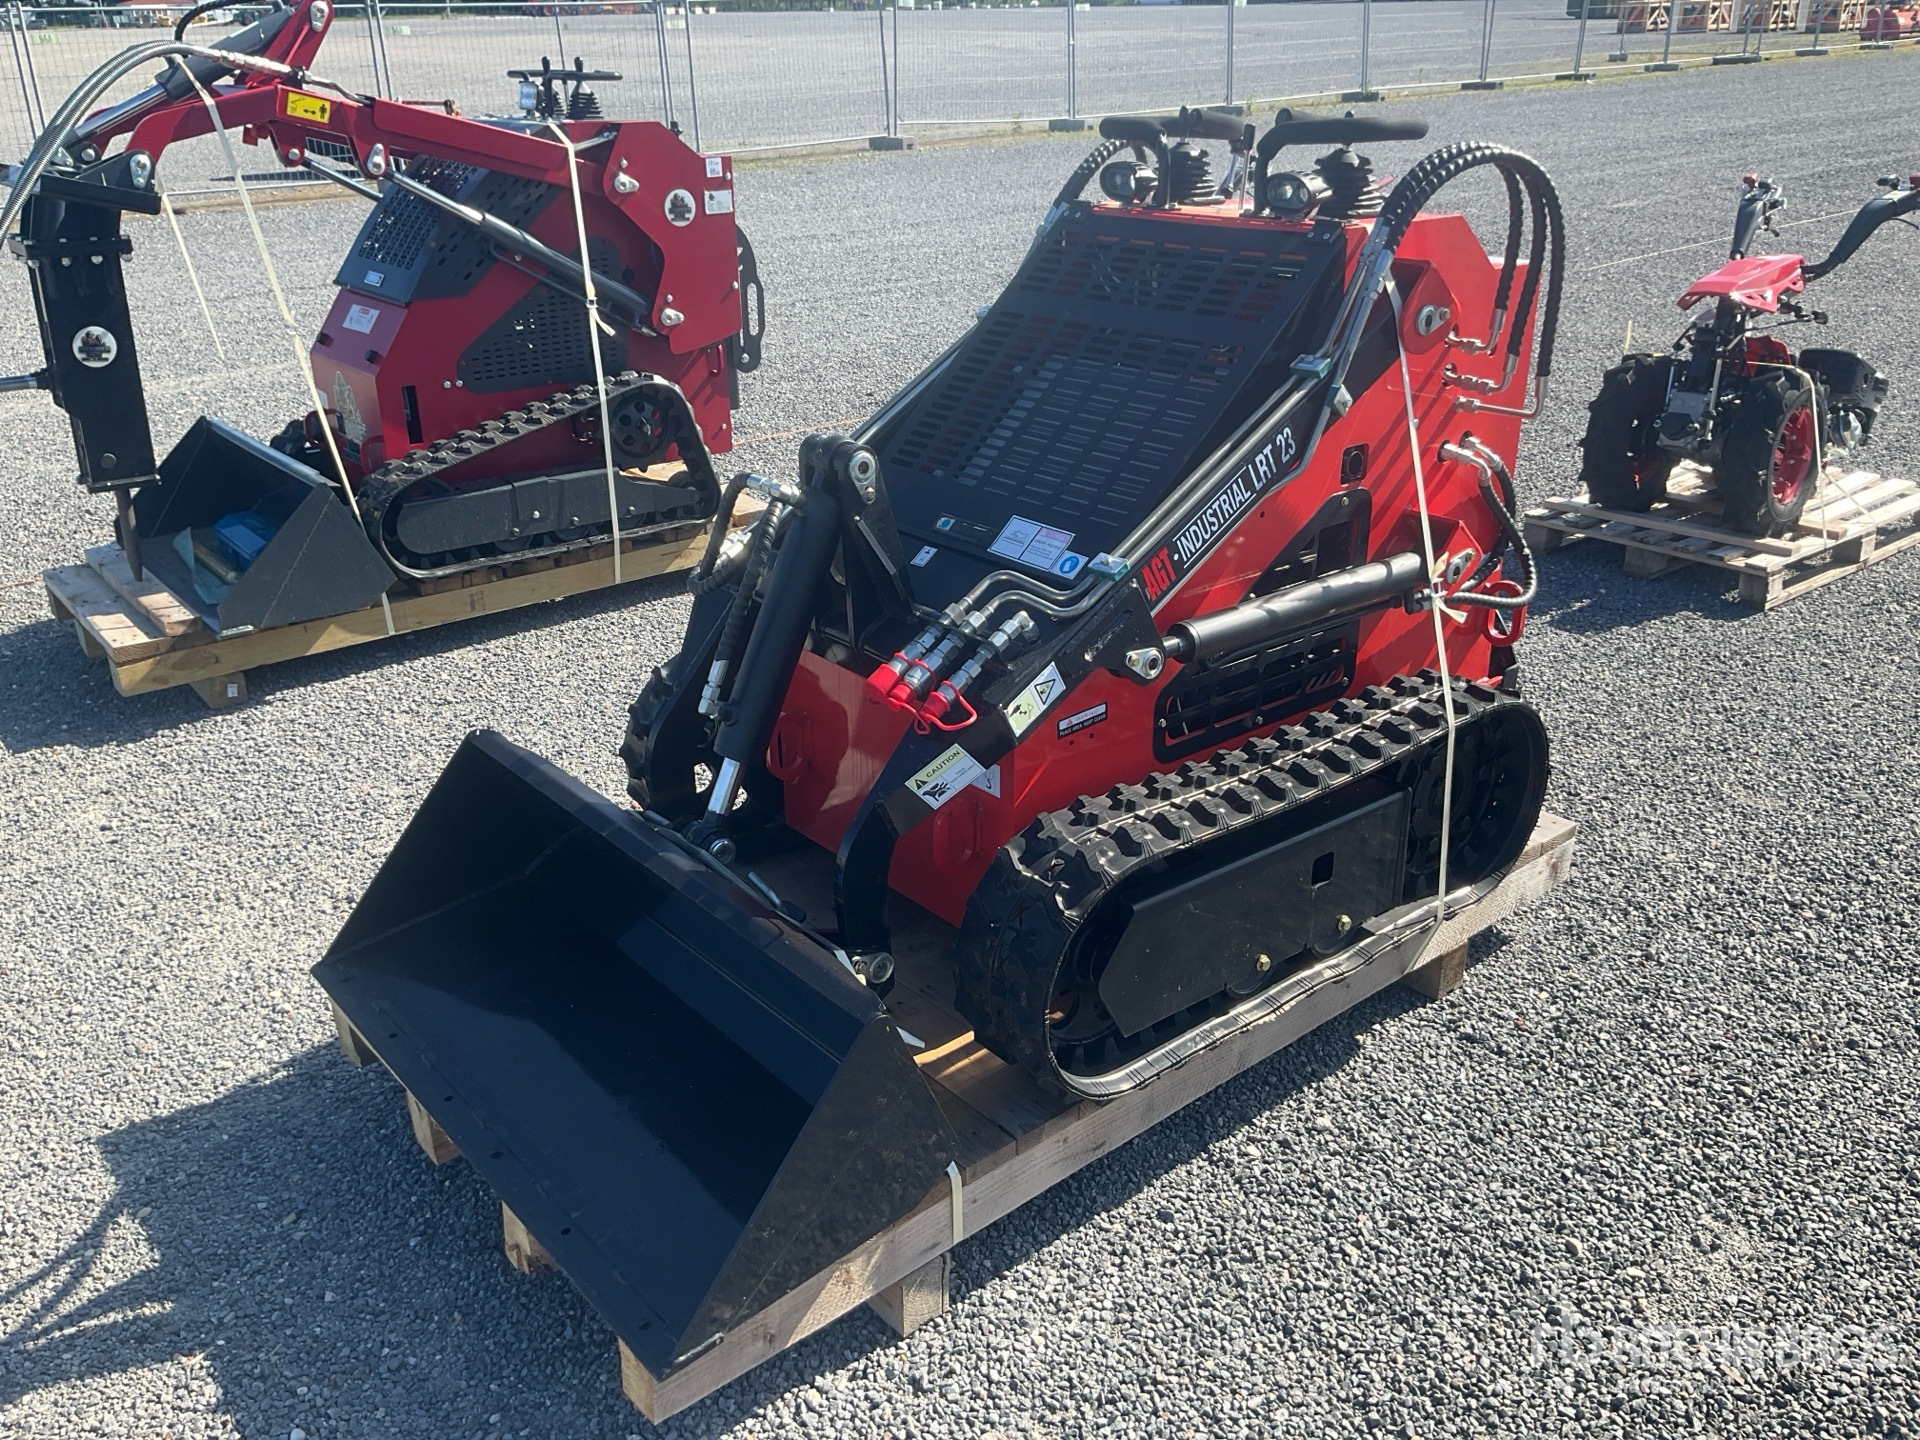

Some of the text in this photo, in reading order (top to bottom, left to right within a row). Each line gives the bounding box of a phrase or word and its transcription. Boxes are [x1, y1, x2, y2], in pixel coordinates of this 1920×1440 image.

[1142, 427, 1296, 601] AGT INDUSTRIAL LRT 23
[926, 750, 960, 778] CAUTION
